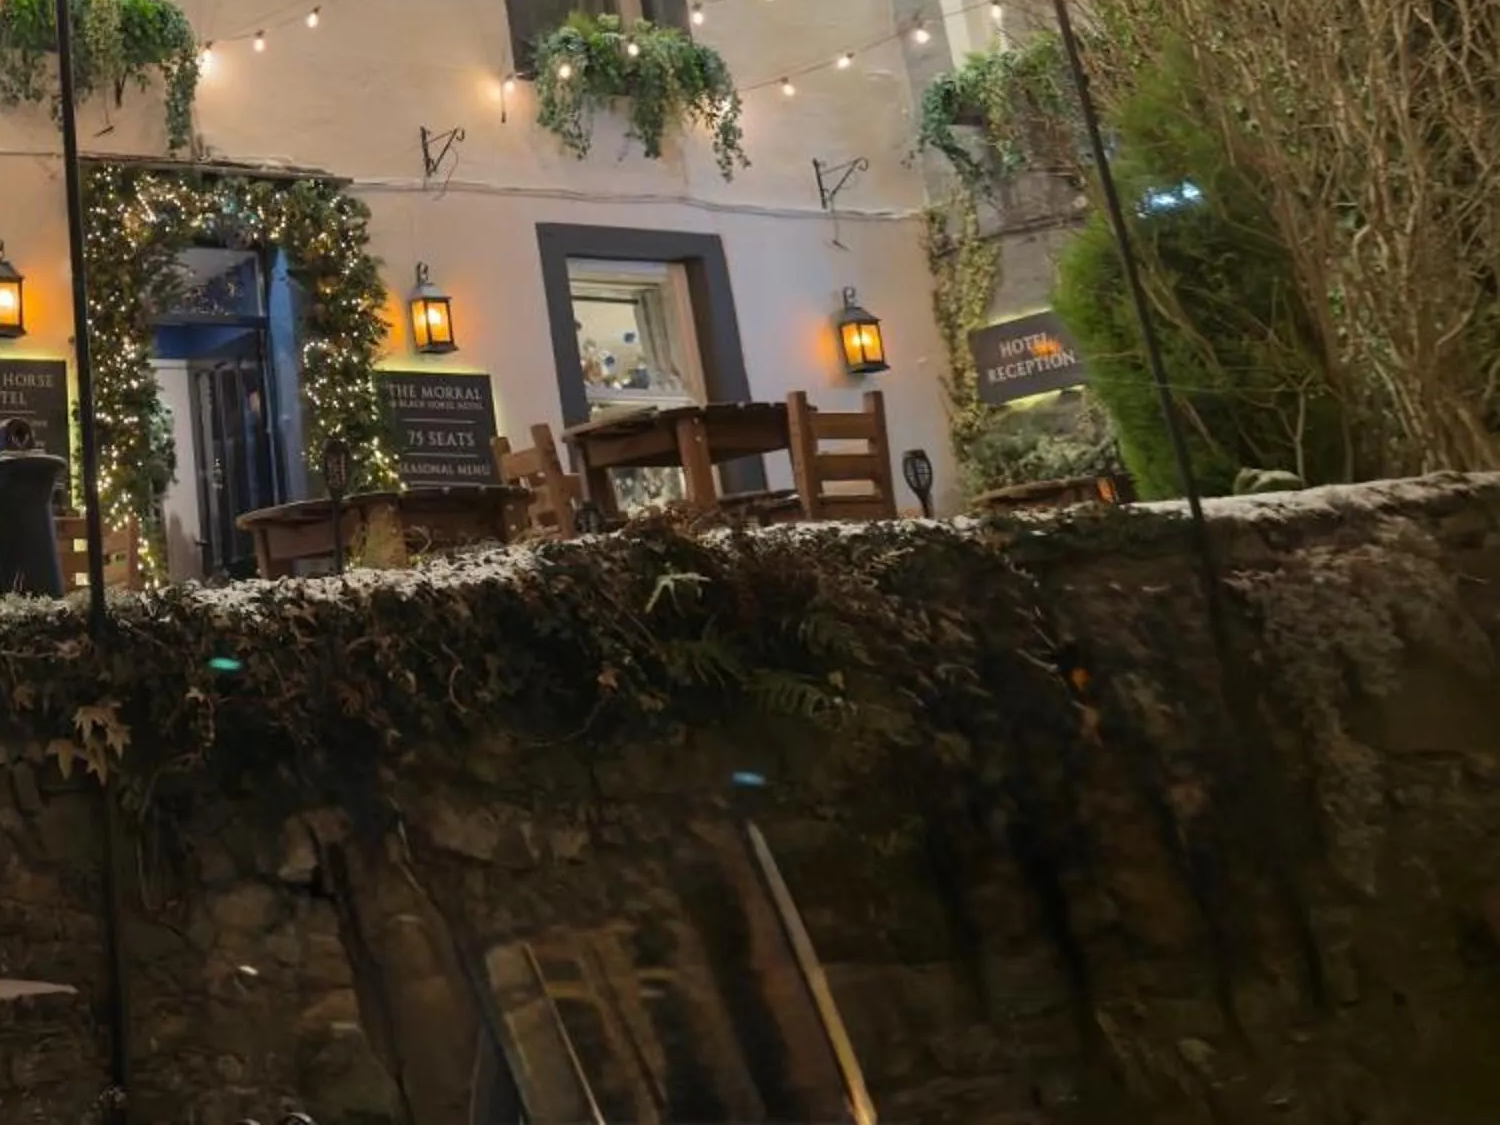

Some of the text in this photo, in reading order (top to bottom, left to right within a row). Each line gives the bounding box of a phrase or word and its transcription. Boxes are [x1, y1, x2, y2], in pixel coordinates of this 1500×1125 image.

[988, 349, 1076, 384] RECEPTION
[3, 372, 54, 388] HORSE
[388, 383, 417, 398] THE
[407, 430, 476, 447] 75 SEATS
